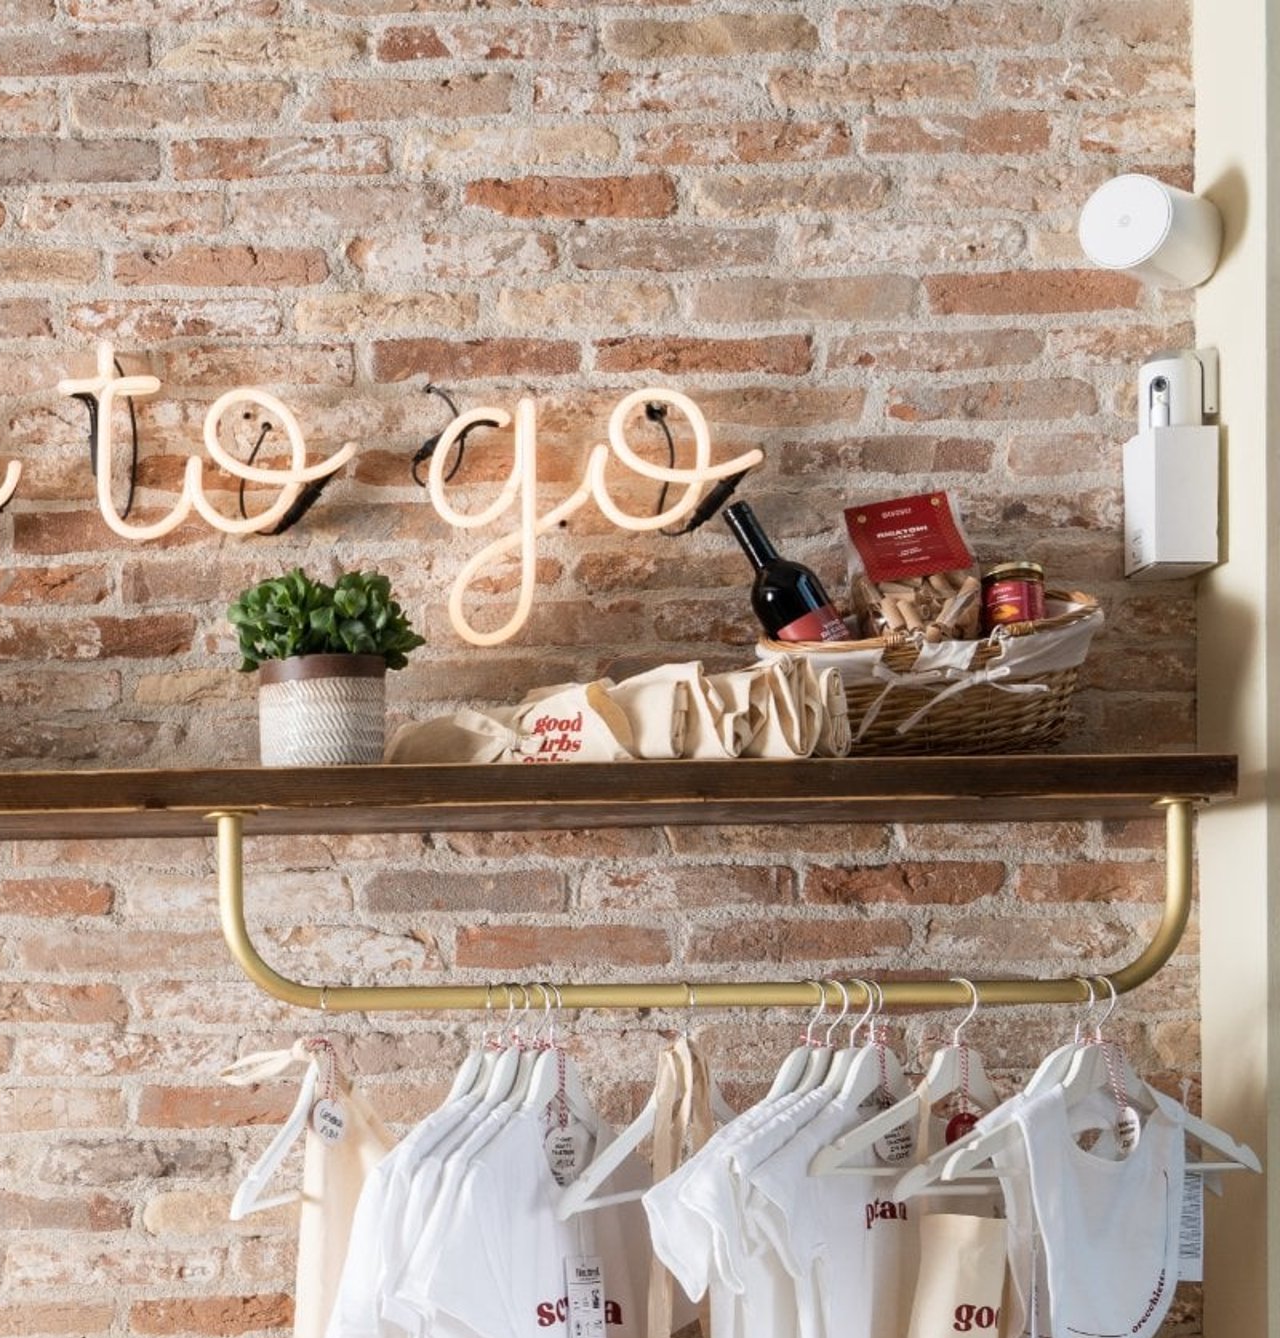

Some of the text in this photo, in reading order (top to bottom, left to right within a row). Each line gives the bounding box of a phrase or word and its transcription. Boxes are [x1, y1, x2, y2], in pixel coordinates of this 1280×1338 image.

[59, 341, 356, 541] to
[428, 387, 765, 646] go
[531, 711, 583, 736] good
